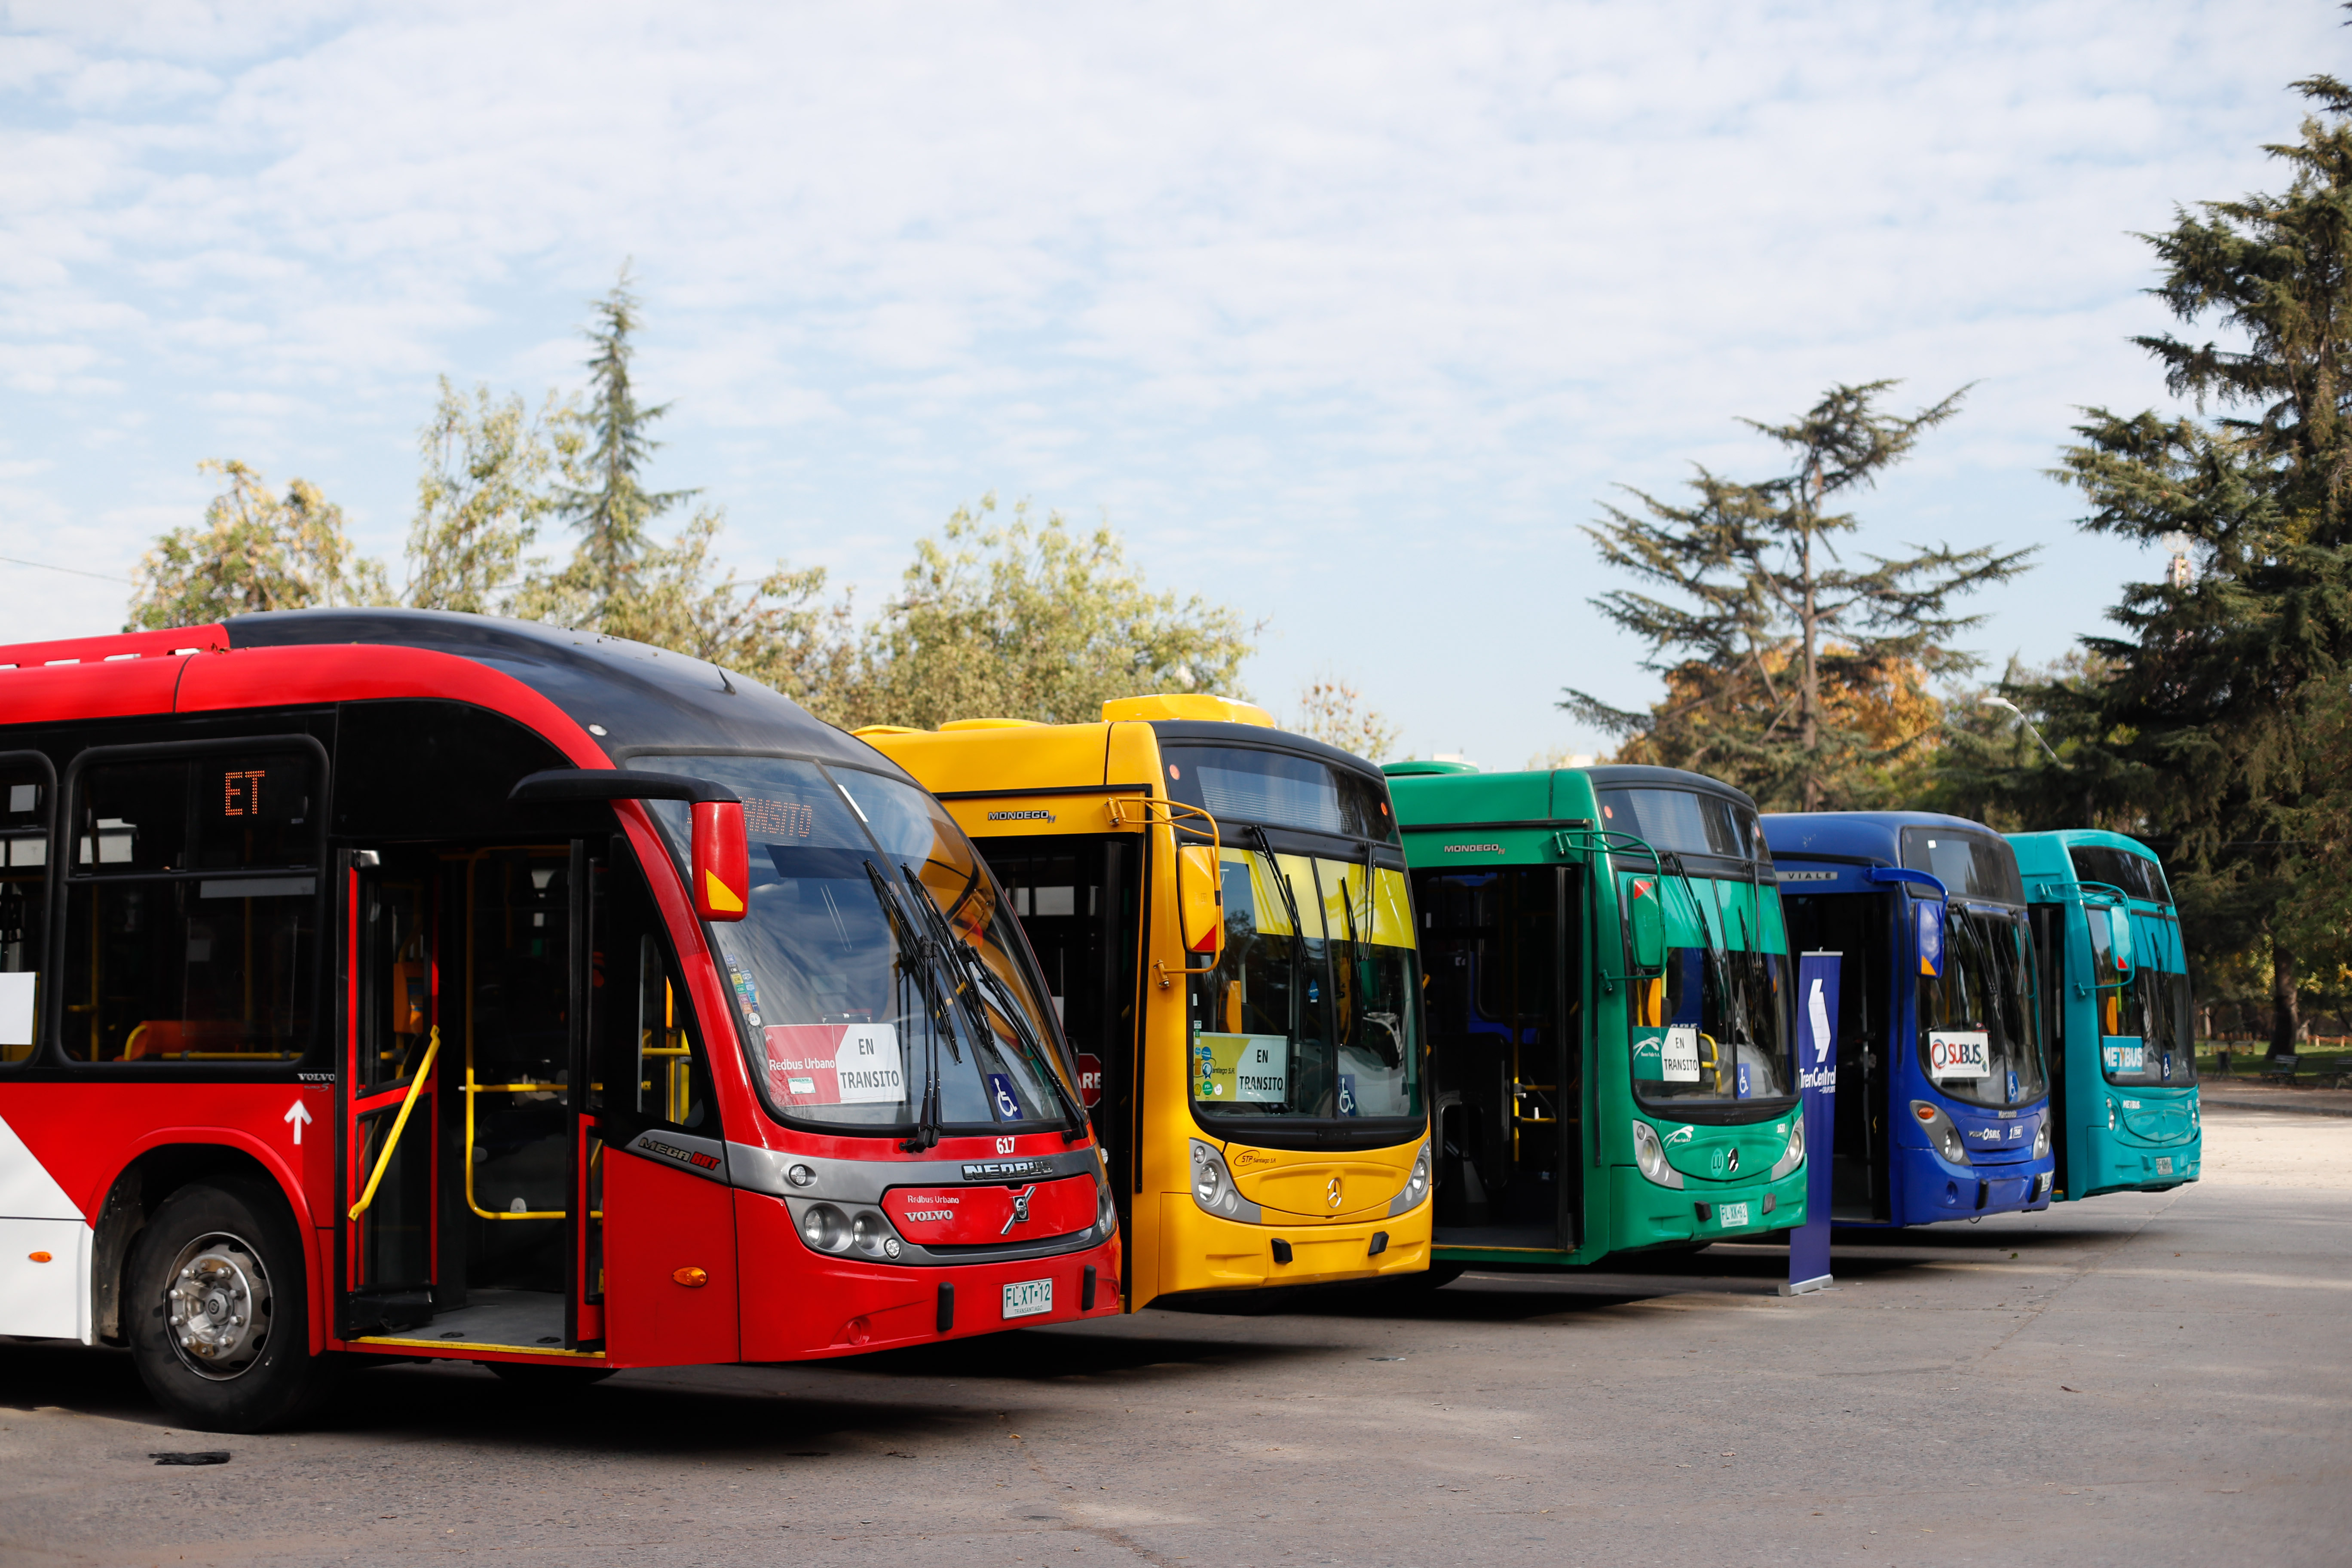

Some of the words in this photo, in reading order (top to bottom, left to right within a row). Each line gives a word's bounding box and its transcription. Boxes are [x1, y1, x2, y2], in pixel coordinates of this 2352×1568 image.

[225, 770, 265, 816] ET
[738, 796, 812, 837] ANSITO
[988, 810, 1049, 821] MONDEGO
[1444, 844, 1499, 852] MONDEGO
[858, 1038, 874, 1055] EN
[1675, 1037, 1684, 1049] EN
[1257, 1049, 1268, 1063] EN
[1948, 1043, 1981, 1064] SUBUS
[2103, 1046, 2143, 1067] METBUS
[769, 1059, 803, 1071] Redbus
[804, 1057, 835, 1069] Urbano
[1664, 1058, 1698, 1071] TRANSITO
[840, 1070, 900, 1089] TRANSITO
[1240, 1076, 1283, 1091] TRANSITO
[1799, 1065, 1836, 1089] TrenCentral
[996, 1137, 1015, 1155] 617
[962, 1160, 1053, 1180] NEOBUS
[907, 1195, 934, 1204] Redbus
[934, 1195, 959, 1204] Urbano
[904, 1210, 953, 1222] VOLVO
